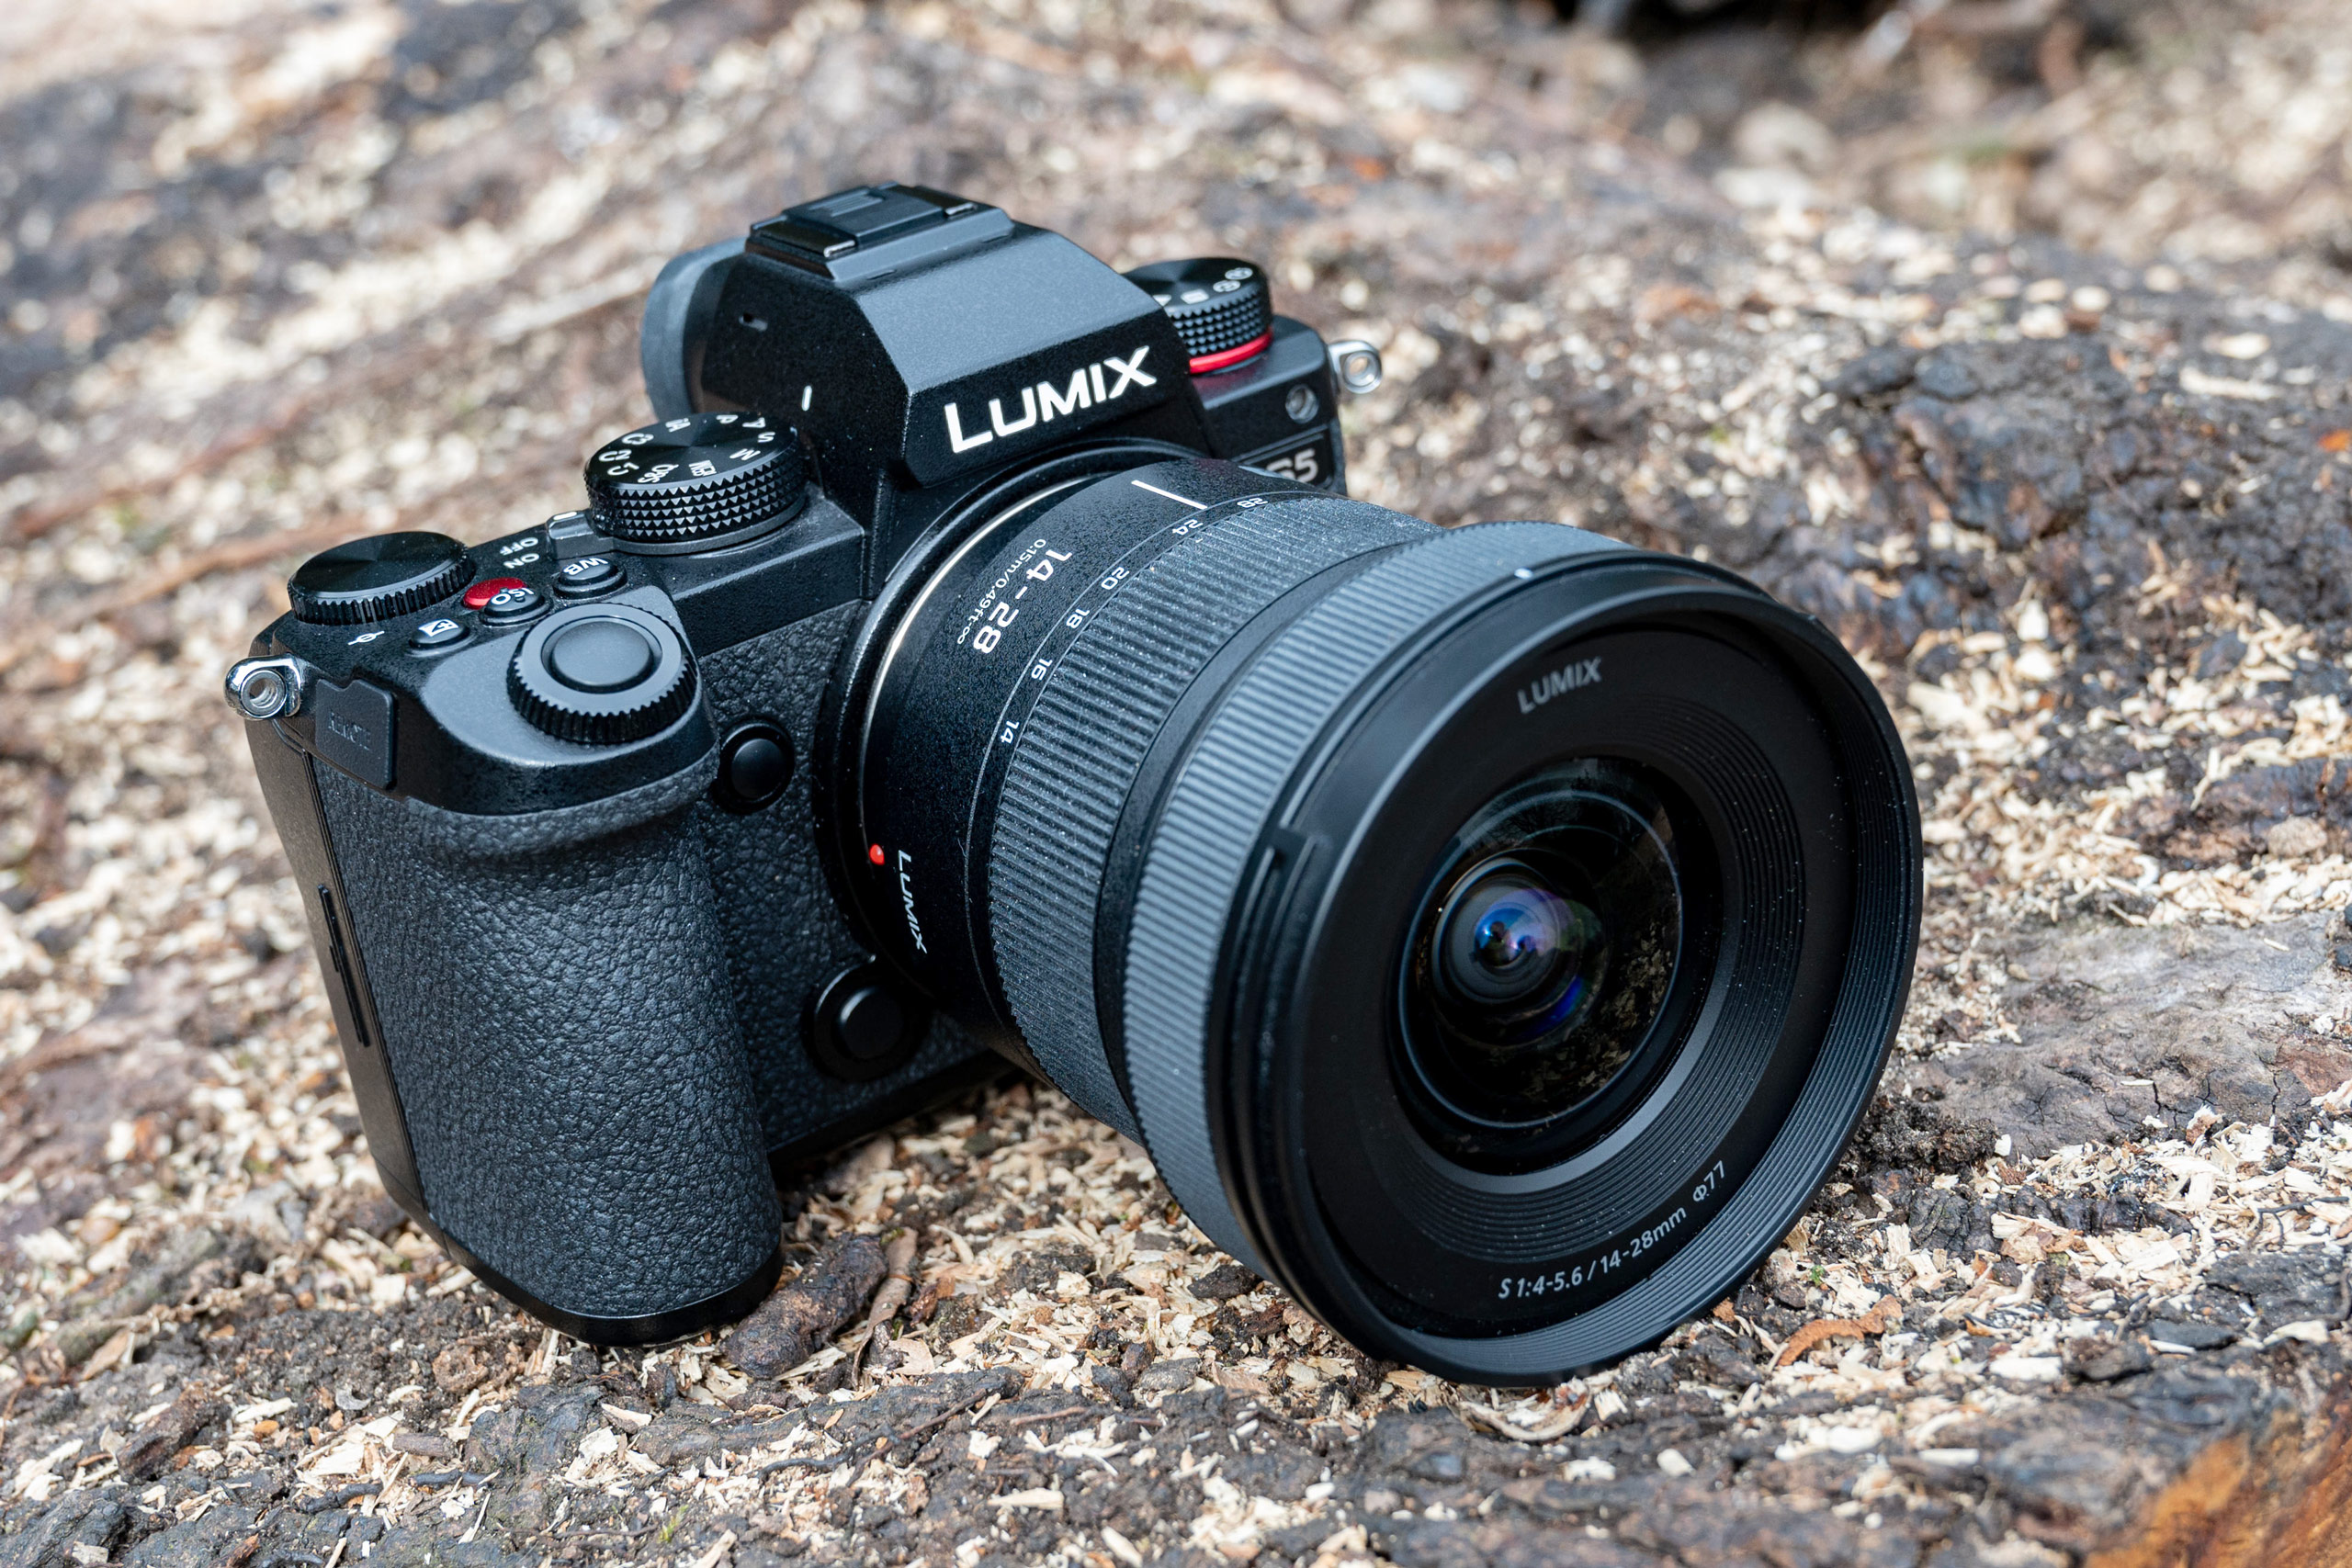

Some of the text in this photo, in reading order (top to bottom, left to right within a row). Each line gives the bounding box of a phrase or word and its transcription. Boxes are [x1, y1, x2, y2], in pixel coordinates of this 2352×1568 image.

[944, 344, 1158, 454] LUMIX
[717, 414, 739, 423] P
[742, 417, 766, 428] A
[622, 433, 653, 445] C3
[757, 432, 775, 443] S
[598, 449, 632, 461] C2
[729, 448, 761, 460] M
[606, 462, 639, 476] C1
[1237, 497, 1268, 508] 28
[1171, 519, 1204, 536] 24
[500, 536, 539, 556] OFF
[503, 552, 540, 570] ON
[563, 557, 609, 576] WB
[1101, 567, 1130, 590] 20
[490, 588, 535, 606] ISO
[1066, 607, 1090, 629] 18
[1031, 658, 1053, 681] 16
[1517, 656, 1601, 714] LUMIX
[1000, 720, 1020, 744] 14
[898, 850, 928, 954] LUMIX
